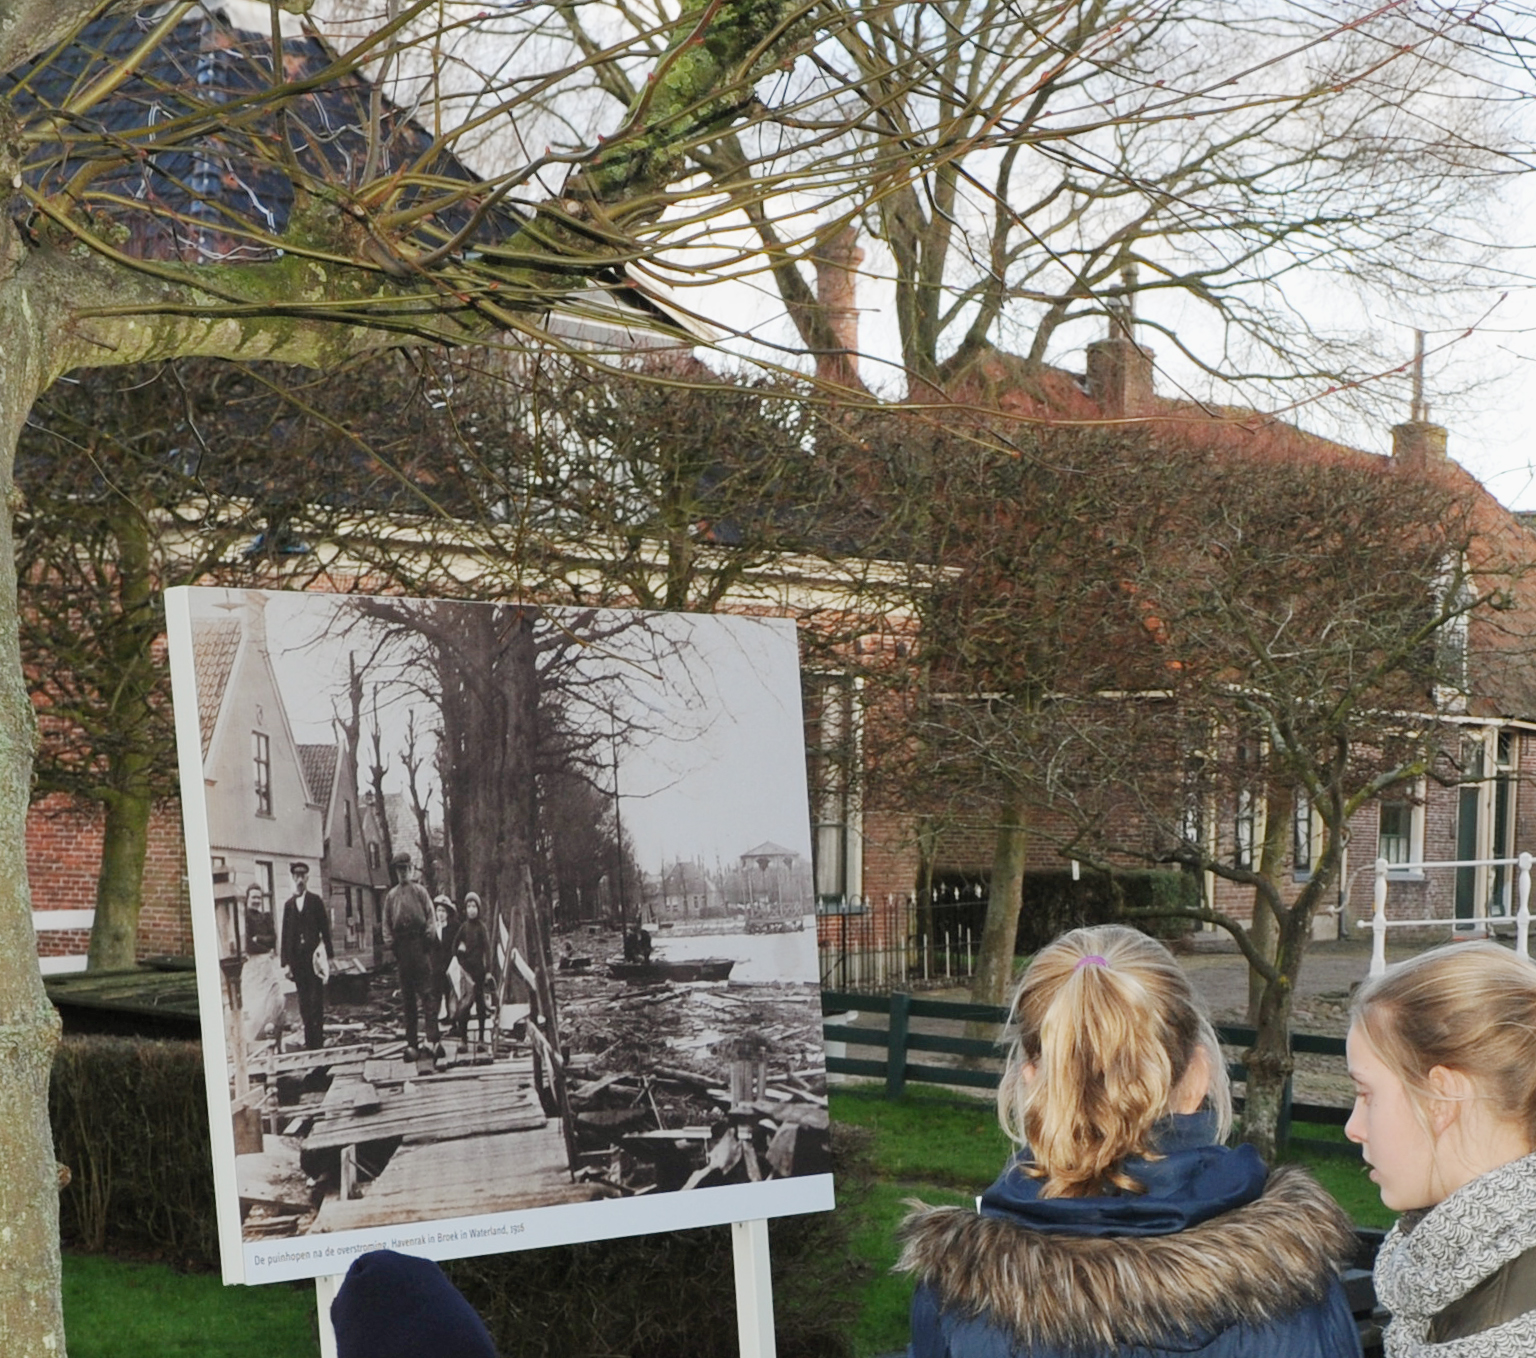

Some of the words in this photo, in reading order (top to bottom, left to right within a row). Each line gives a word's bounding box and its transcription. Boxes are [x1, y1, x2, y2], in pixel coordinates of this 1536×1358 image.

[254, 1255, 266, 1266] De
[268, 1252, 311, 1266] puinhopen
[313, 1249, 323, 1258] na
[325, 1247, 335, 1257] de
[391, 1235, 427, 1248] Havenrak
[428, 1235, 436, 1244] in
[437, 1231, 458, 1243] Broek
[460, 1231, 468, 1240] in
[469, 1225, 509, 1238] Waterland,
